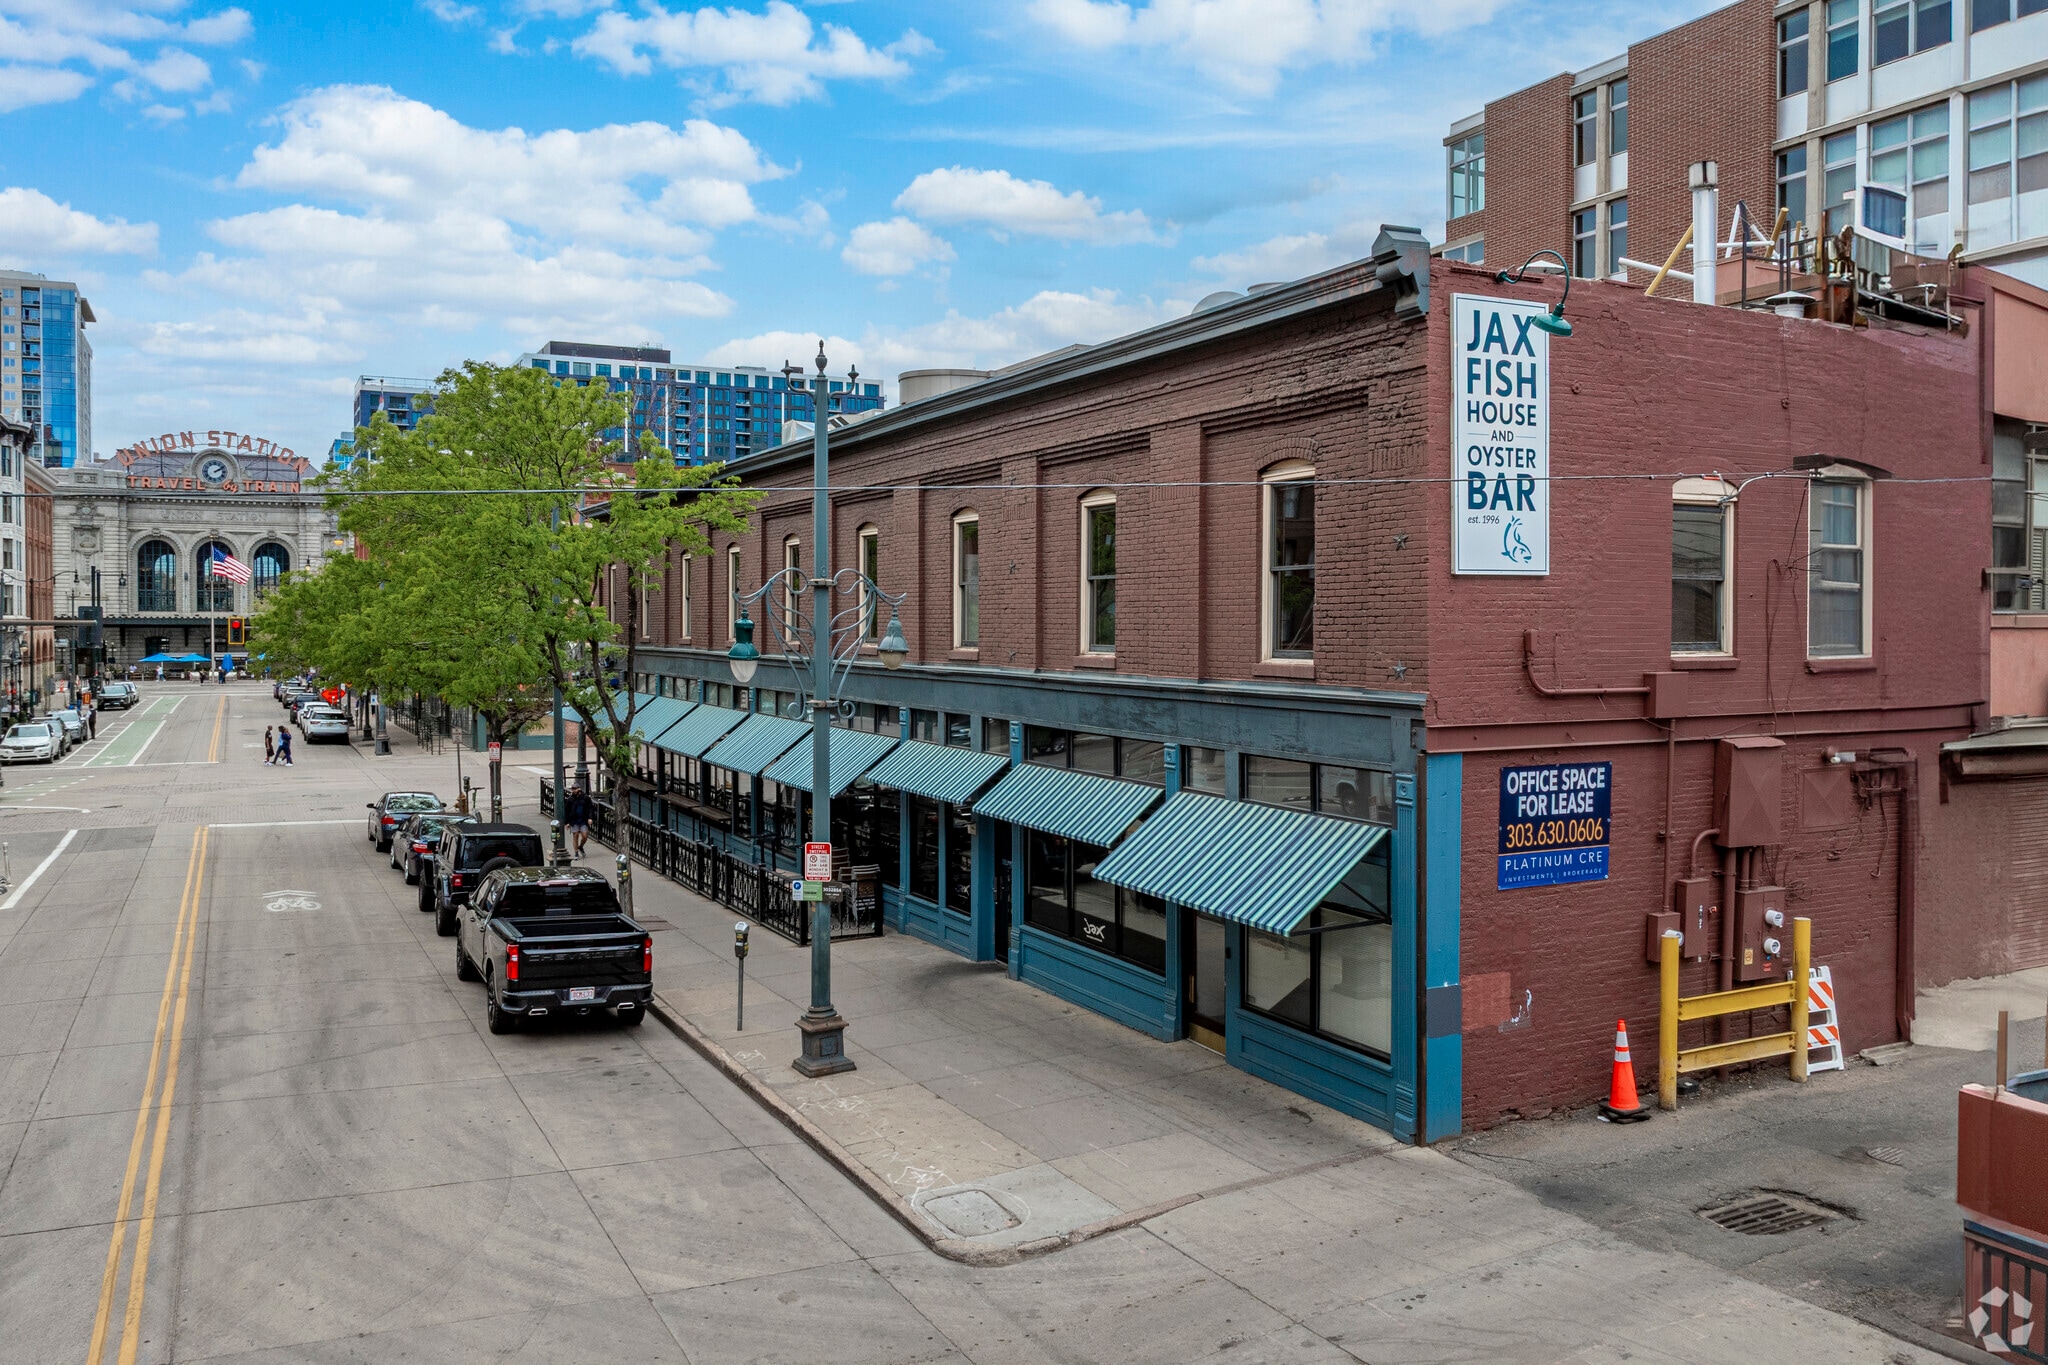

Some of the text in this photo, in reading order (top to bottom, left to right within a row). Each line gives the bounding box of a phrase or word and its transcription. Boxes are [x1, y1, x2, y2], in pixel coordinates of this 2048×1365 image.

[1467, 310, 1536, 358] JAX
[1467, 358, 1537, 399] FISH
[1467, 400, 1537, 427] HOUSE
[1491, 430, 1514, 442] AND
[115, 430, 311, 474] UNION STATION
[1467, 445, 1536, 469] OYSTER
[127, 475, 300, 493] TRAVEL by TRAIN
[1467, 471, 1536, 512] BAR
[160, 511, 204, 521] UNION
[1468, 515, 1500, 525] est. 1996
[1507, 767, 1606, 795] OFFICE SPACE
[1518, 792, 1594, 817] FOR LEASE
[1506, 818, 1604, 848] 303.630.0606
[1505, 851, 1603, 871] PLATINUM CRE
[1505, 868, 1602, 883] INVESTMENTS BROKERAGE
